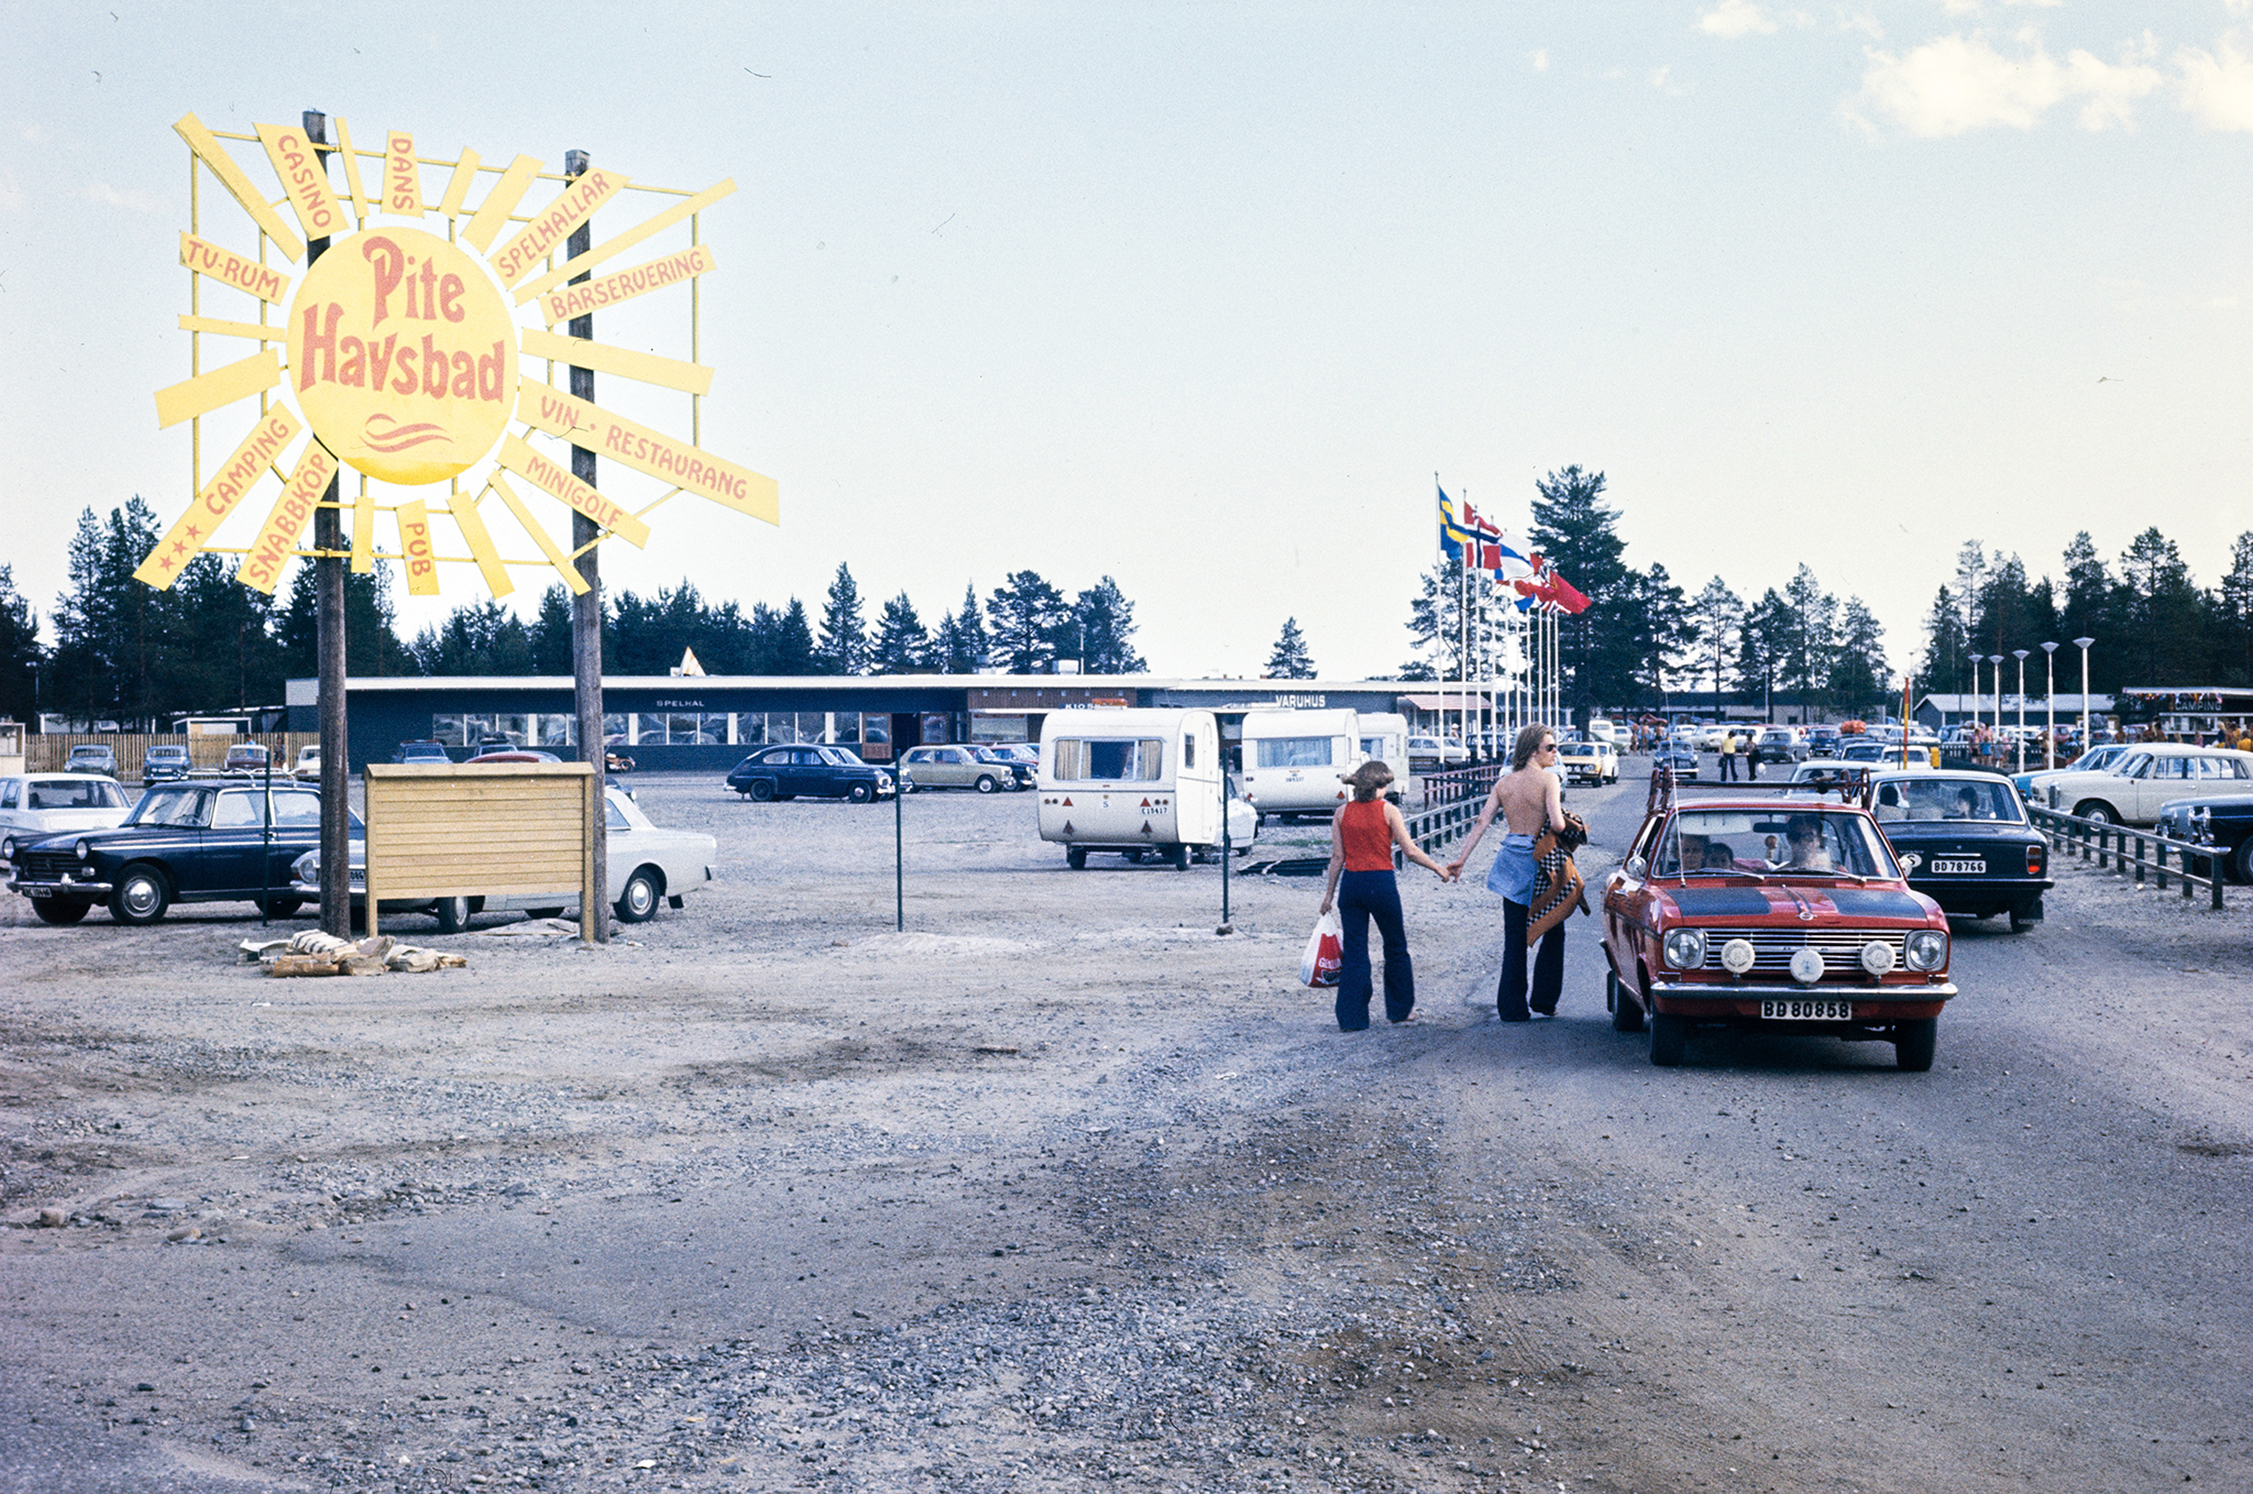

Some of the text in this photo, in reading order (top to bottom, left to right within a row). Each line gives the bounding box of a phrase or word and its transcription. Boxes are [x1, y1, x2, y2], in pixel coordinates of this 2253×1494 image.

[278, 134, 332, 228] CASINO
[391, 137, 415, 210] DANS
[499, 172, 611, 279] SPELHALLAR
[362, 235, 466, 332] Pite
[299, 301, 505, 404] Havsbad
[205, 417, 290, 516] CAMPING
[525, 456, 623, 527] MINIGOLF
[605, 424, 748, 501] RESTAURANG
[249, 452, 329, 585] SNABBKÖP
[405, 521, 432, 577] PUB
[1275, 694, 1326, 708] VARUHUS
[2174, 701, 2221, 711] CAMPING
